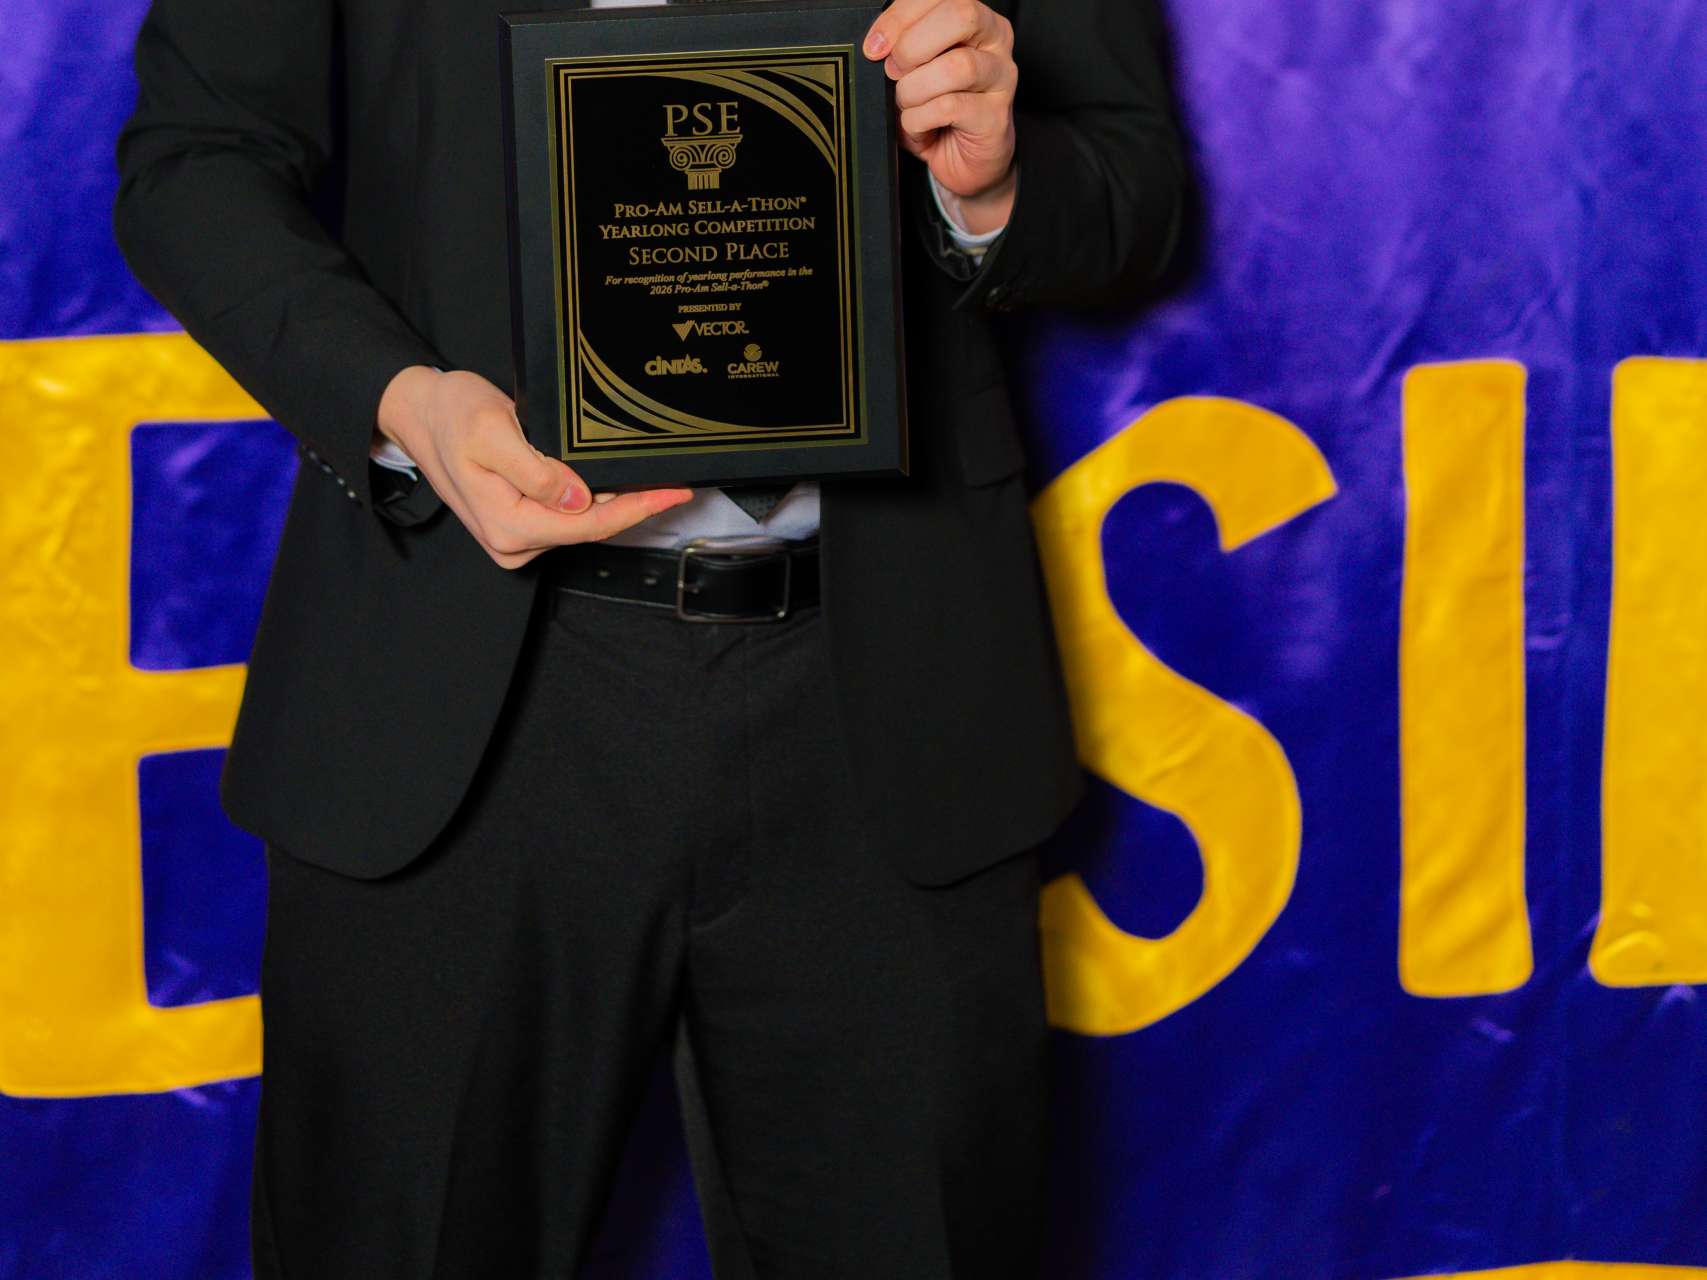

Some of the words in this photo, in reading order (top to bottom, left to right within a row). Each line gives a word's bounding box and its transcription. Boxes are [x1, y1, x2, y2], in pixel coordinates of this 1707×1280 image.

[662, 101, 741, 137] PSE
[613, 201, 684, 218] PRO-AM
[599, 223, 690, 239] YEARLONG
[694, 217, 815, 235] COMPETITION
[629, 246, 718, 266] SECOND
[725, 242, 790, 261] PLACE
[605, 275, 622, 285] For
[624, 273, 675, 286] recognition
[677, 271, 688, 284] of
[686, 270, 728, 283] yearlong
[728, 269, 786, 281] performance
[787, 267, 797, 276] in
[798, 266, 813, 276] the
[650, 285, 673, 295] 2026
[674, 283, 709, 294] Pro-Am
[678, 303, 728, 313] PRESENTED
[729, 303, 742, 311] BY
[727, 361, 779, 374] CAREW
